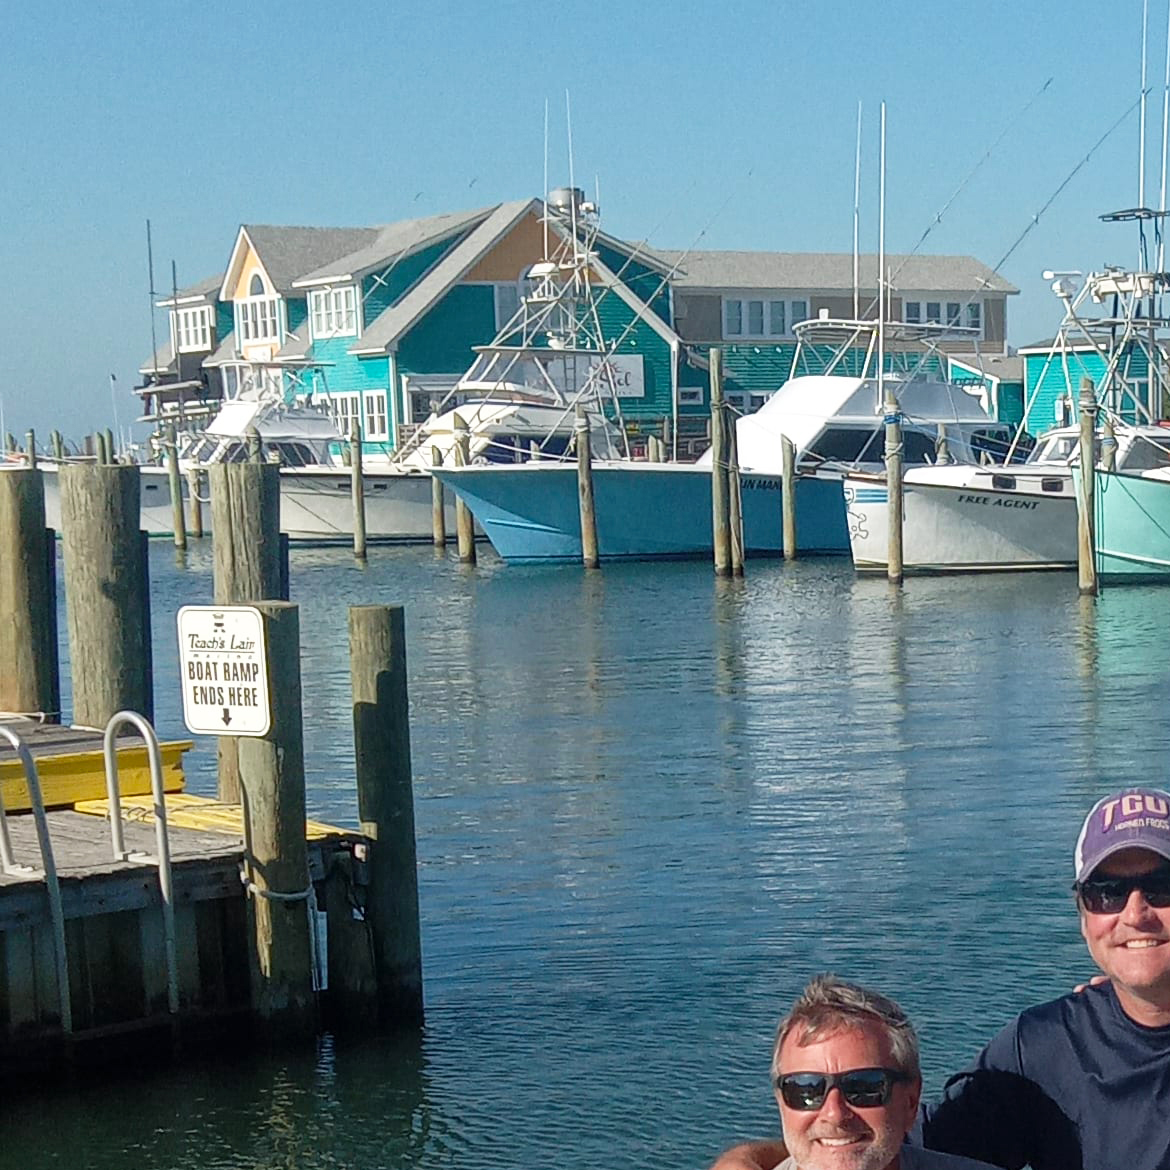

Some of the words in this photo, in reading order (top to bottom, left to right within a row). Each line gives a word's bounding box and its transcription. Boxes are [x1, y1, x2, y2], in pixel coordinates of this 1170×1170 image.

[958, 495, 990, 505] FREE
[993, 498, 1040, 510] AGENT
[188, 634, 225, 649] Teach's
[230, 634, 255, 650] Lair
[188, 661, 218, 681] BOAT
[223, 662, 259, 682] RAMP
[193, 686, 224, 705] ENDS
[228, 687, 258, 706] HERE
